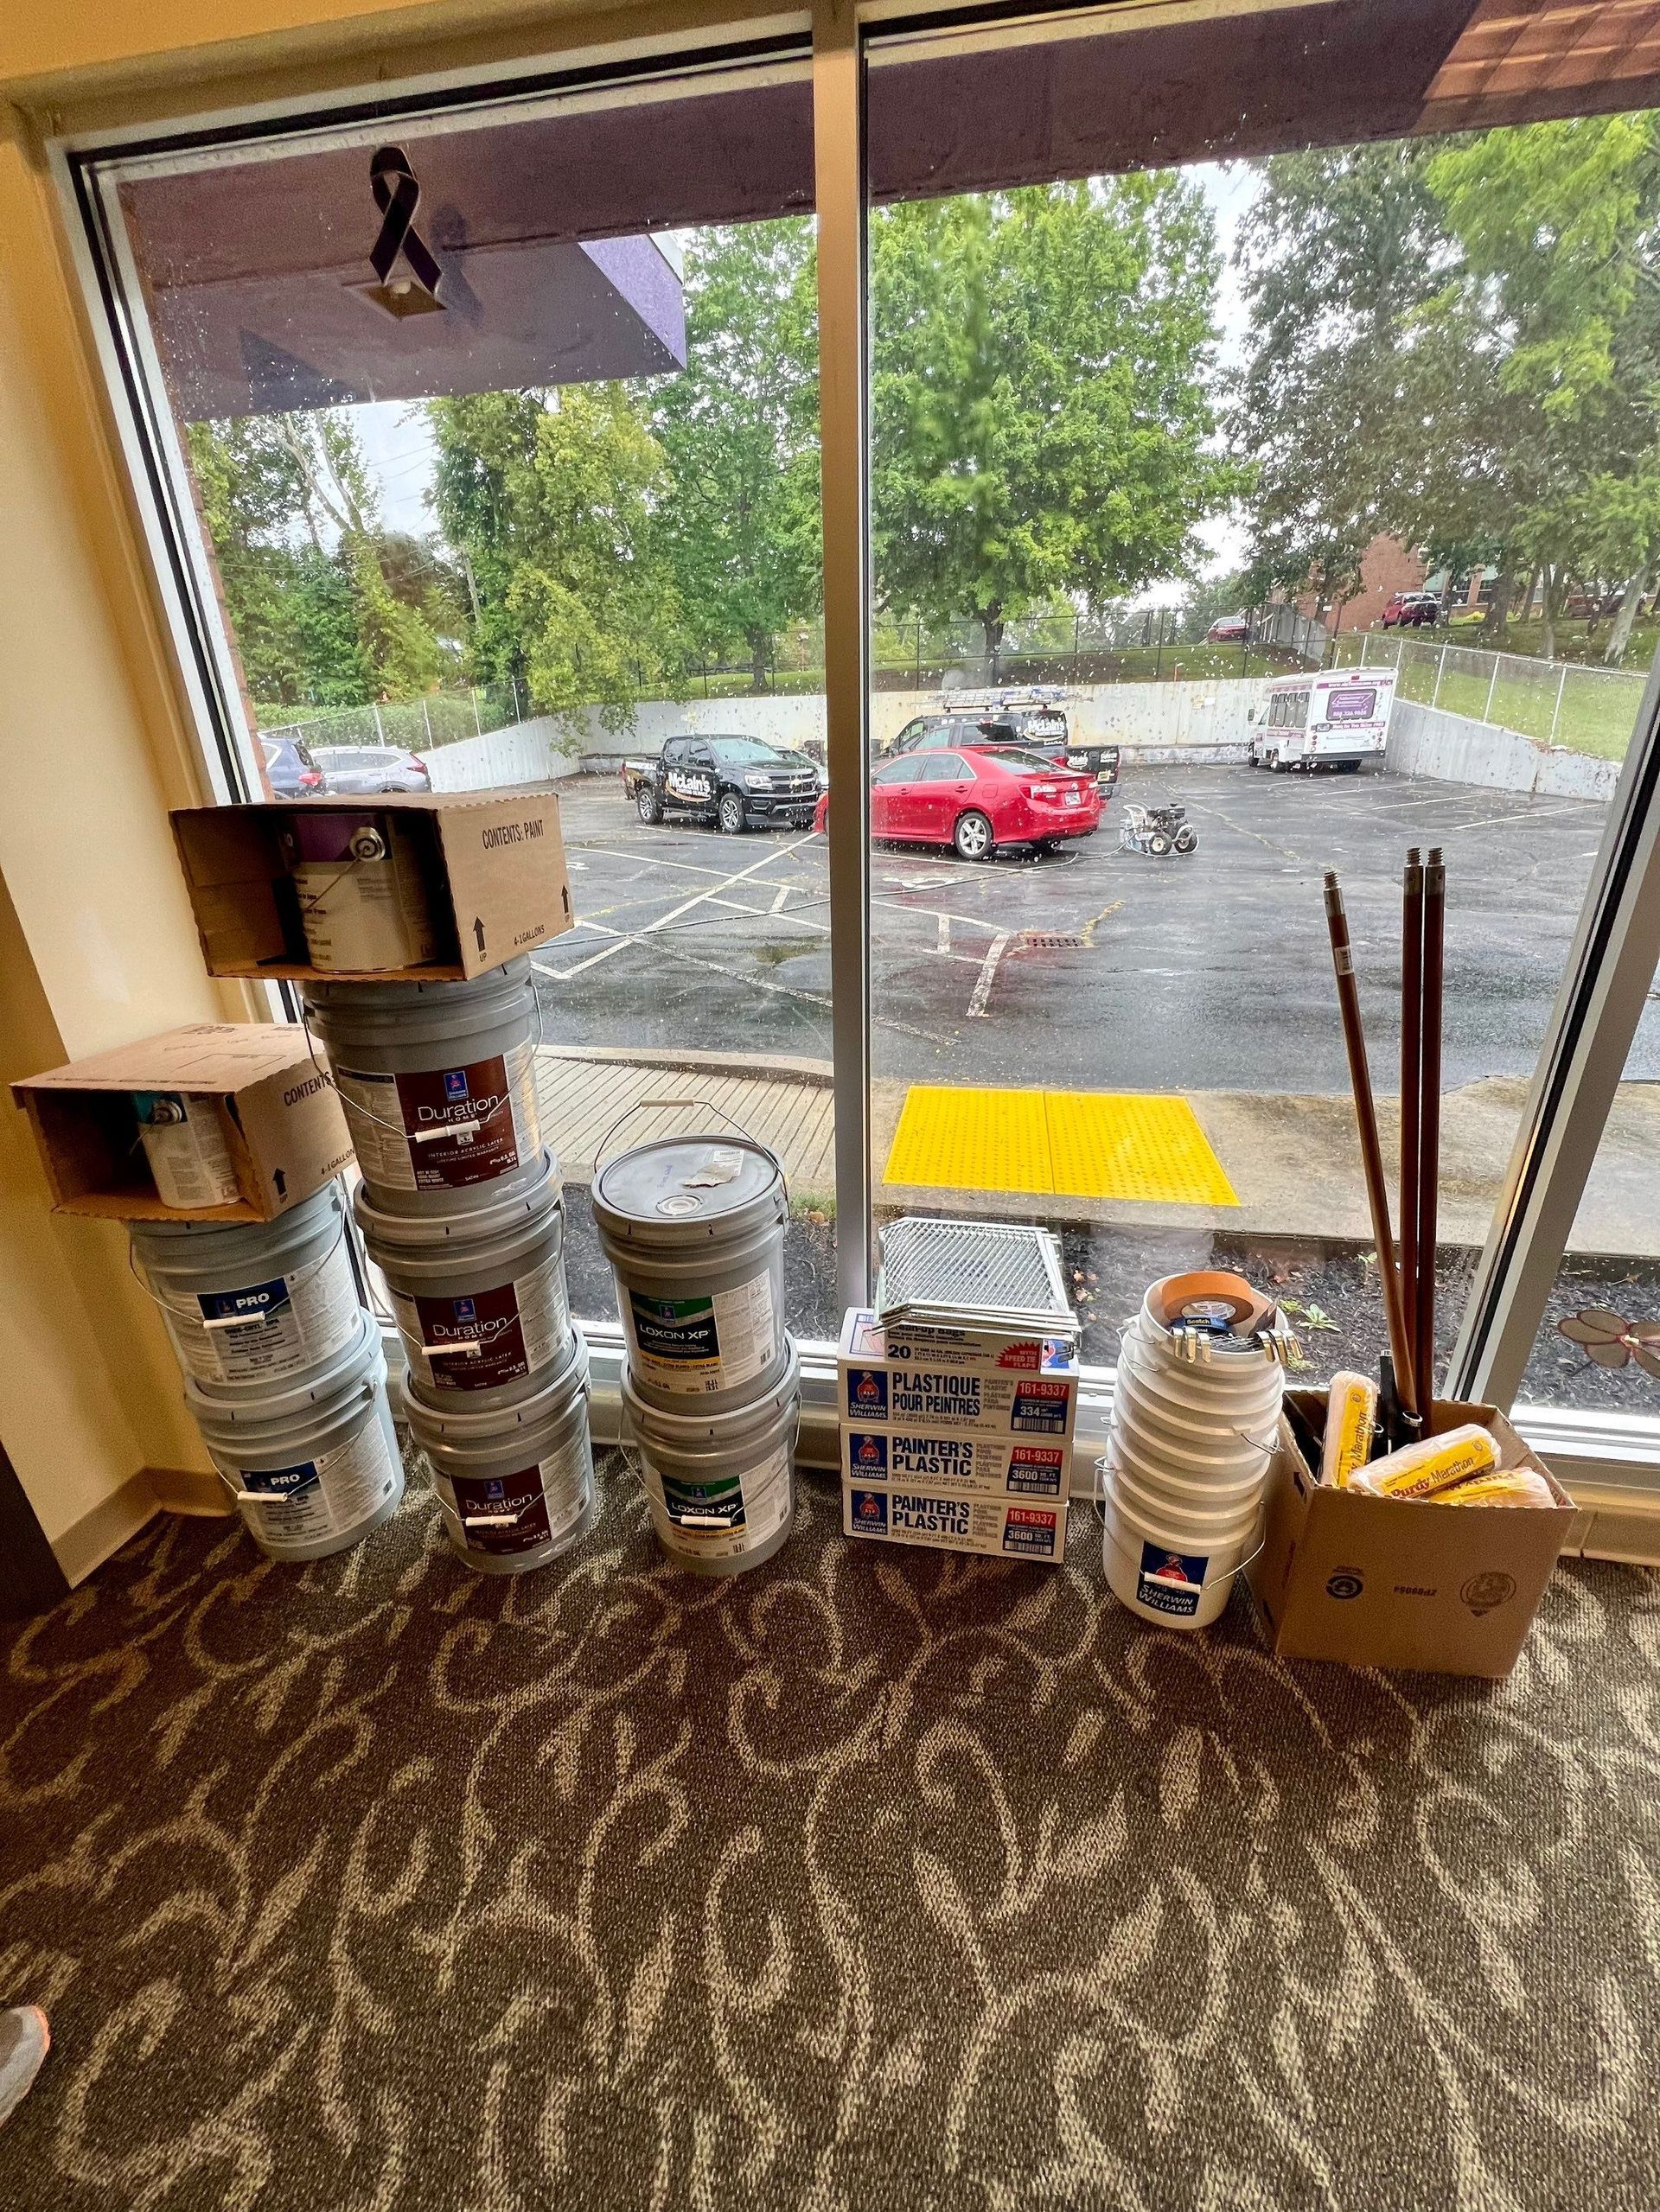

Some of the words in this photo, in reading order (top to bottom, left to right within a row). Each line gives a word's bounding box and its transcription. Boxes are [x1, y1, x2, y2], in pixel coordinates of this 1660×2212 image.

[667, 772, 711, 794] McLain's
[482, 822, 524, 850] CONTENTS:
[524, 819, 544, 839] PAINT
[479, 953, 488, 963] UP
[418, 1095, 499, 1121] Duration
[279, 1195, 288, 1204] UP
[235, 1292, 270, 1309] PRO
[433, 1317, 508, 1336] Duration
[640, 1323, 685, 1340] LOXON
[888, 1344, 911, 1359] 20
[892, 1372, 980, 1397] PLASTIQUE
[1020, 1383, 1066, 1397] 161-9337
[850, 1402, 886, 1412] SHERWIN
[892, 1393, 923, 1412] POUR
[926, 1394, 980, 1416] PEINTRES
[1020, 1406, 1040, 1416] 334
[849, 1409, 887, 1418] WILLIAMS
[1350, 1412, 1367, 1460] Marathon
[892, 1437, 974, 1458] PAINTER'S
[1015, 1449, 1060, 1463] 161-9337
[852, 1463, 885, 1472] SHERWIN
[892, 1455, 972, 1476] PLASTIC
[270, 1474, 300, 1485] PRO
[851, 1469, 887, 1479] WILLIAMS
[1012, 1469, 1038, 1481] 3600
[1391, 1478, 1431, 1498] Purdy
[1430, 1457, 1474, 1484] Marathon
[466, 1494, 533, 1511] Duration
[672, 1501, 715, 1514] LOXON
[892, 1495, 970, 1518] PAINTER'S
[853, 1517, 886, 1527] SHERWIN
[892, 1511, 968, 1535] PLASTIC
[1010, 1509, 1053, 1525] 161-9337
[852, 1523, 886, 1533] WILLIAMS
[1008, 1529, 1033, 1541] 3600
[1139, 1591, 1193, 1613] WILLIAMS
[1141, 1584, 1193, 1605] SHERWIN
